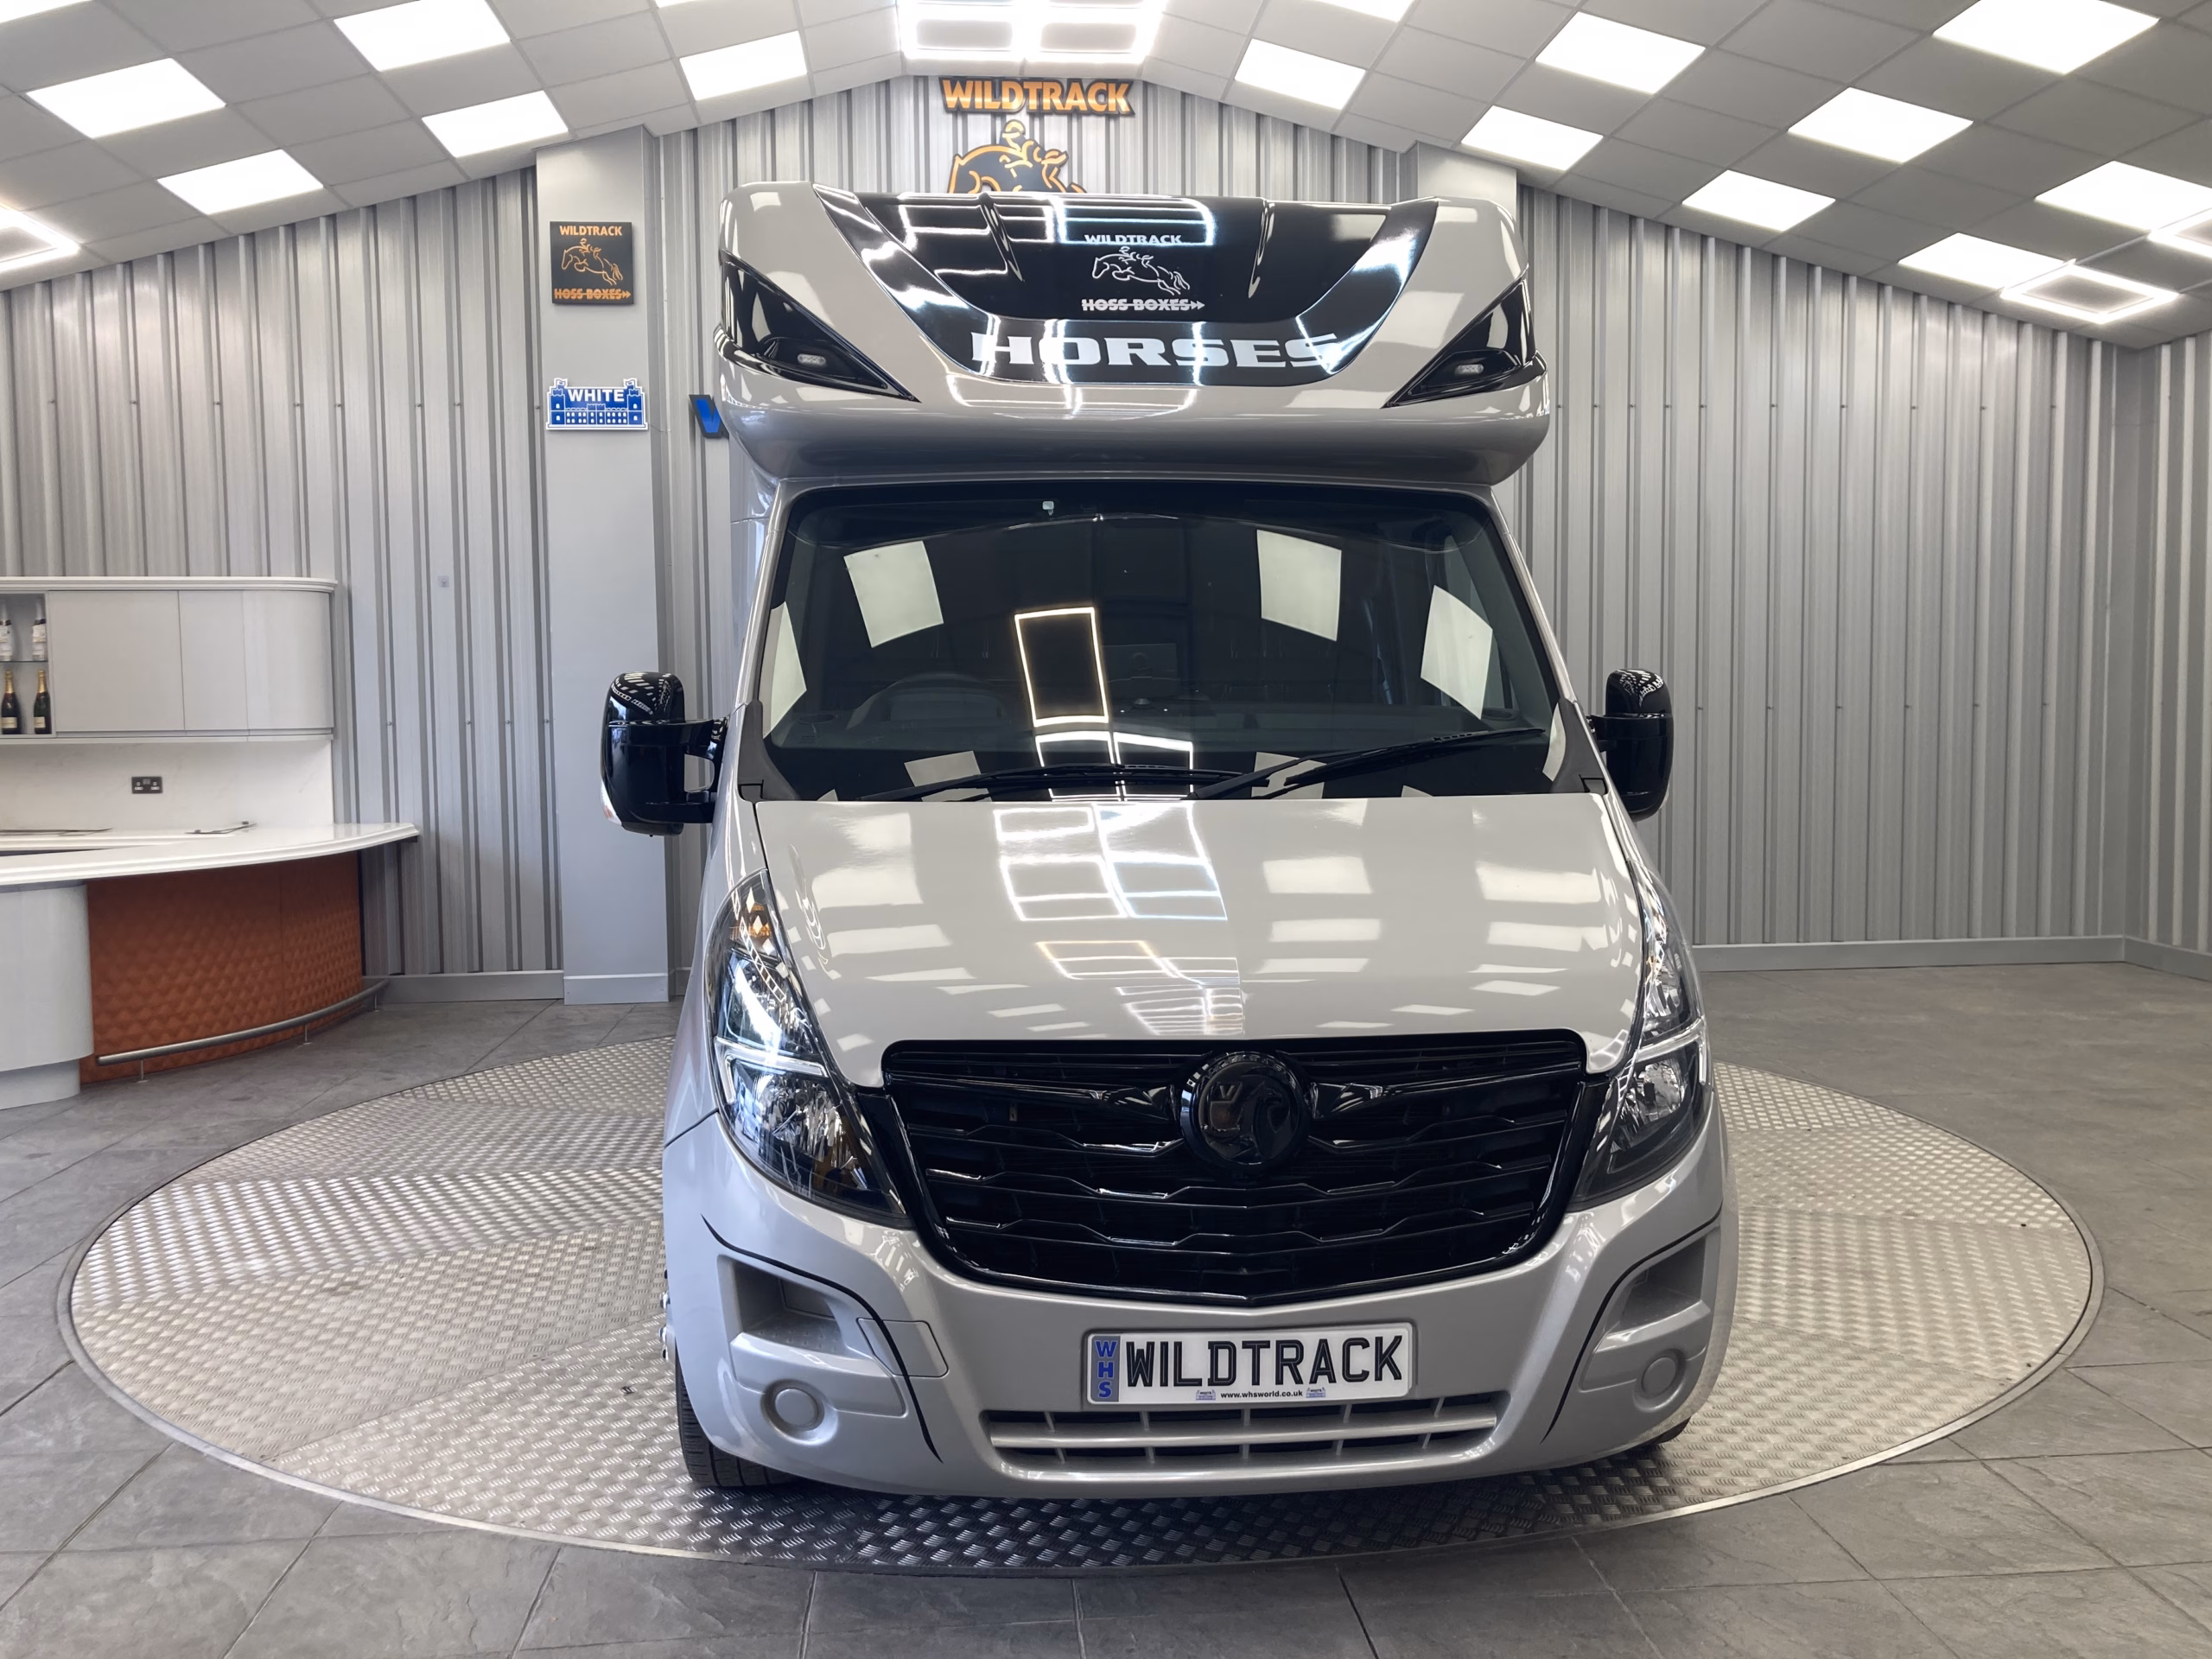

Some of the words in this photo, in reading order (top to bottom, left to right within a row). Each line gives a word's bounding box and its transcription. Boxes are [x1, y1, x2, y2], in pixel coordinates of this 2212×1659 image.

[943, 79, 1131, 111] WILDTRACK
[560, 226, 622, 237] WILDTRACK
[1084, 234, 1181, 245] WILDTRACK
[554, 288, 583, 300] HOSS
[587, 288, 622, 300] BOXES
[1082, 298, 1128, 311] HOSS
[1133, 298, 1190, 311] BOXES
[971, 333, 1337, 368] HORSES
[568, 389, 625, 402] WHITE
[1126, 1335, 1402, 1387] WILDTRACK
